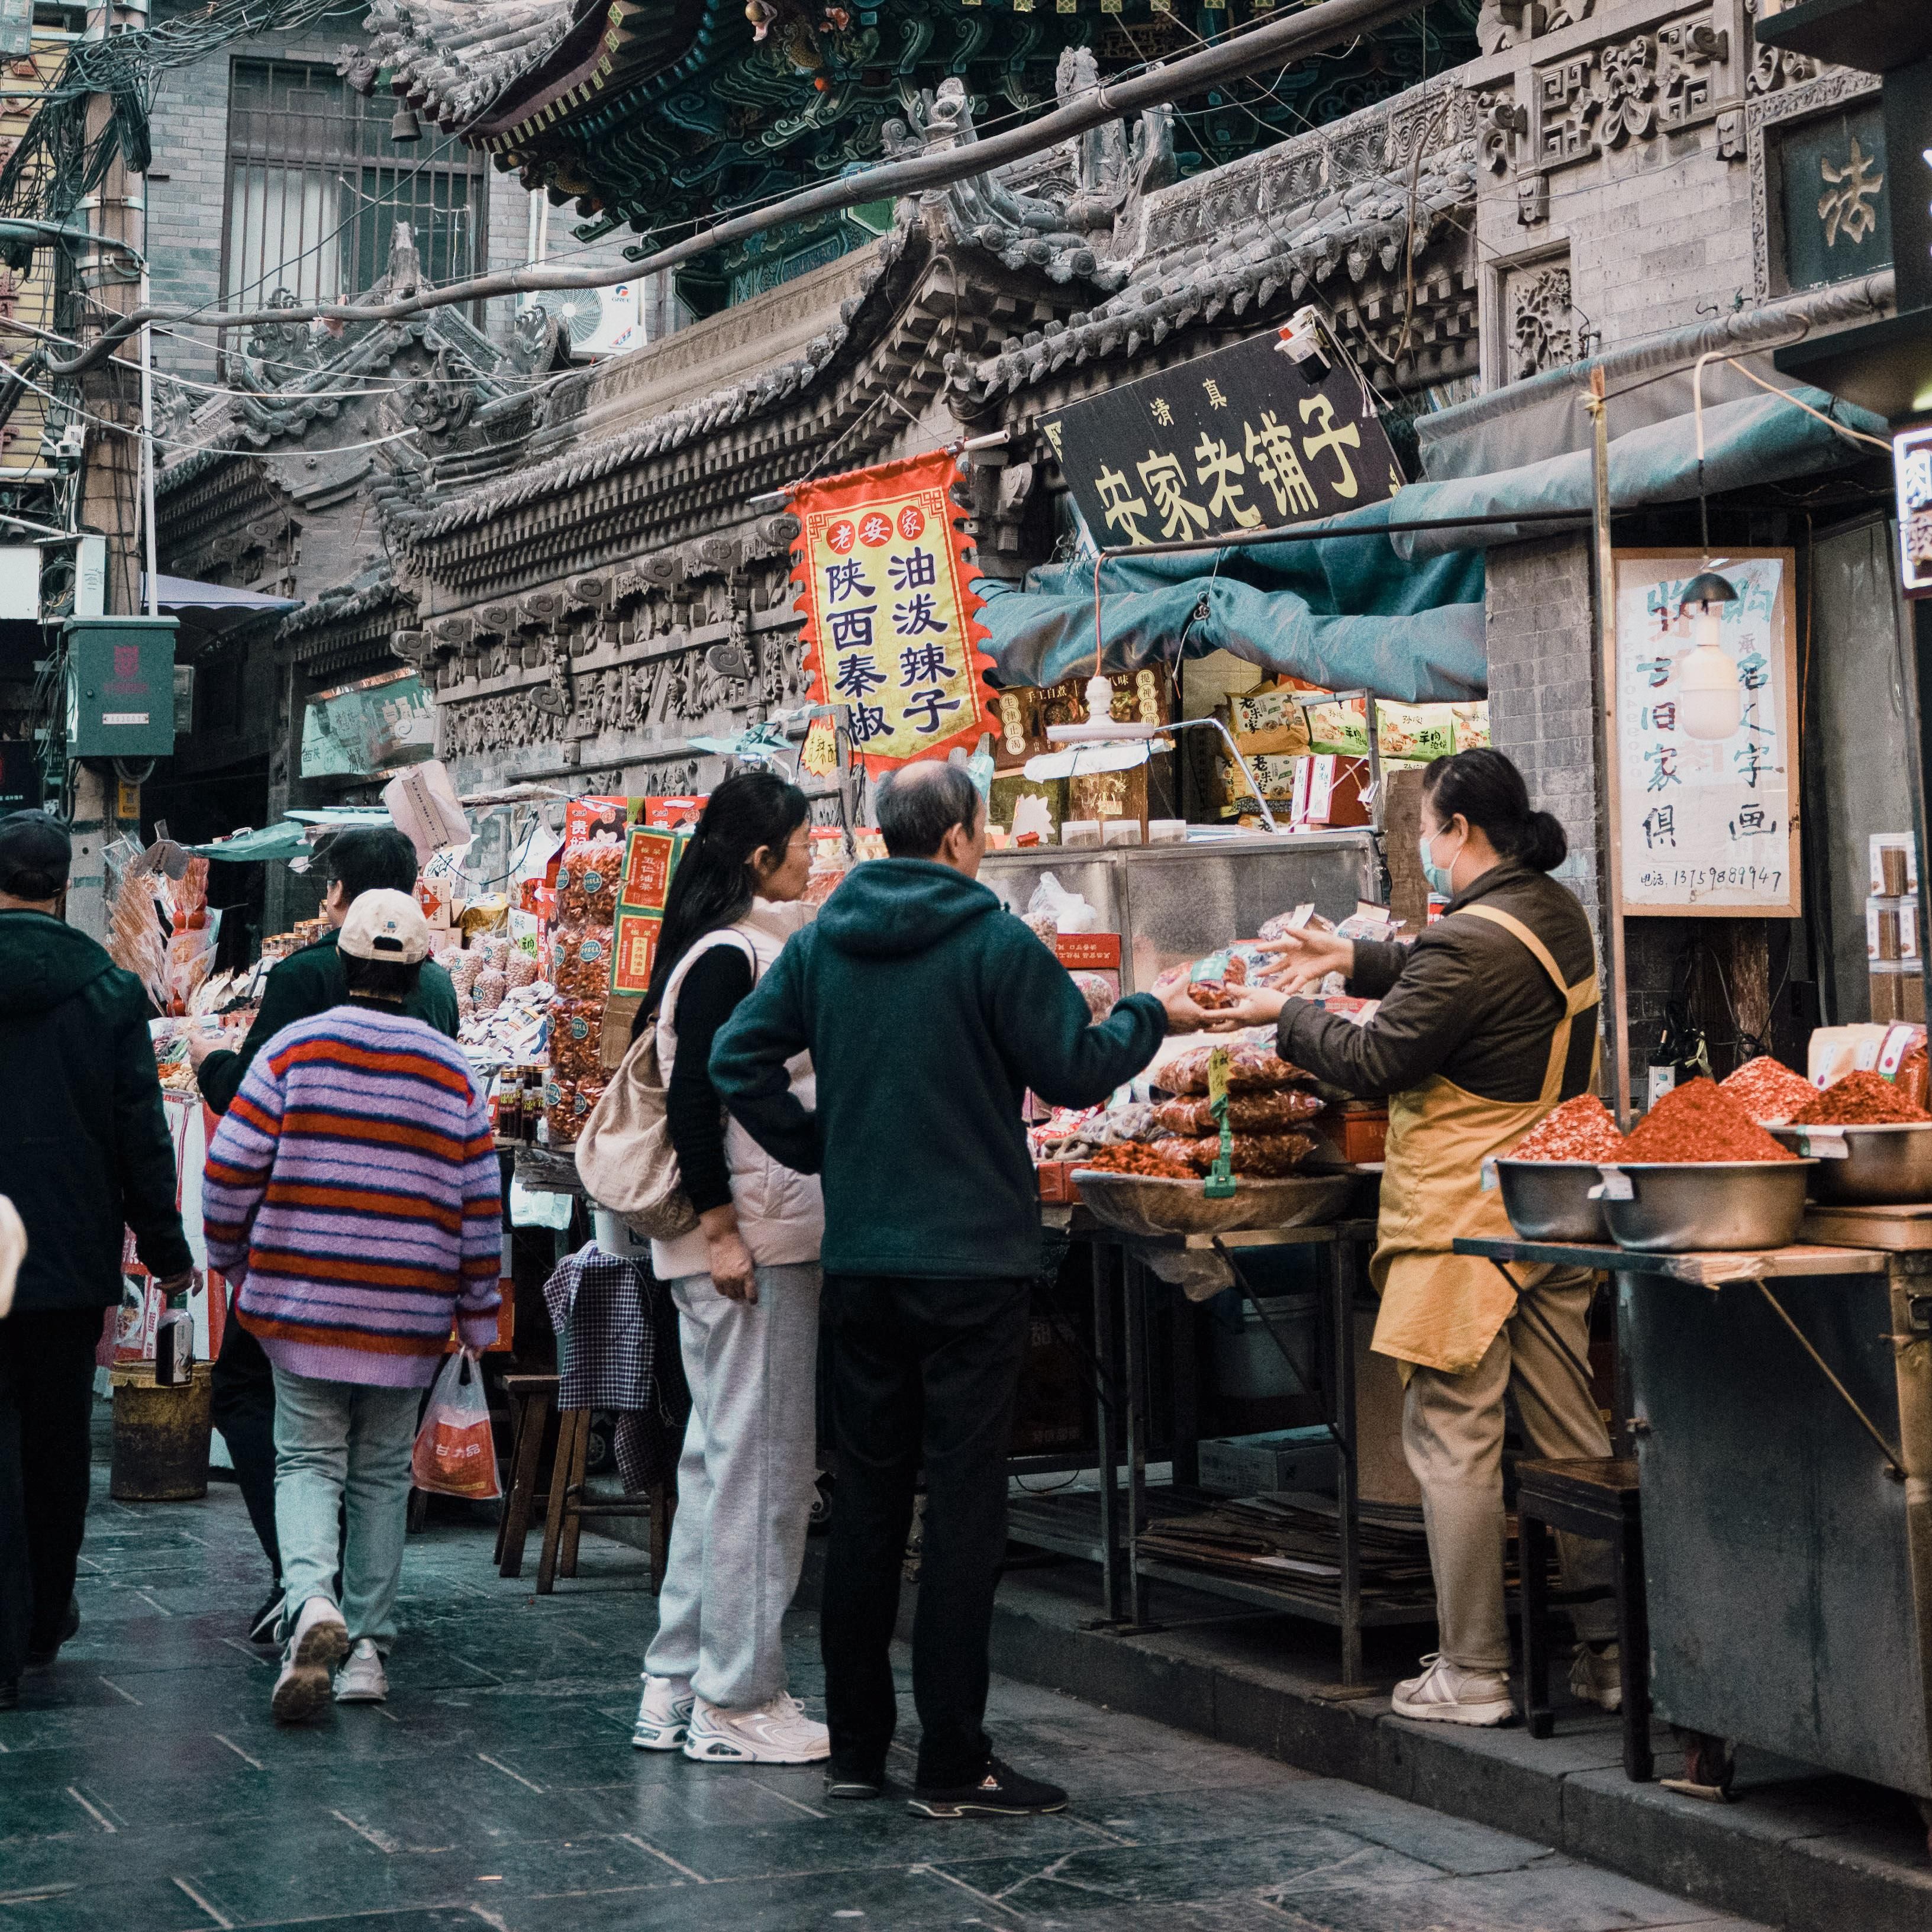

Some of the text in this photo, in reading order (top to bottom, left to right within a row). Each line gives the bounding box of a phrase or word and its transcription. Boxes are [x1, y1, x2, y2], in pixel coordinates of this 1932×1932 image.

[1150, 378, 1227, 427] 清真
[1094, 393, 1361, 546] 安家老铺子
[830, 509, 922, 552] 老安家
[825, 557, 895, 747] 陕西秦椒
[886, 546, 961, 736] 油泼辣子
[1419, 730, 1441, 746] 羊肉
[1674, 866, 1782, 892] 13759889947
